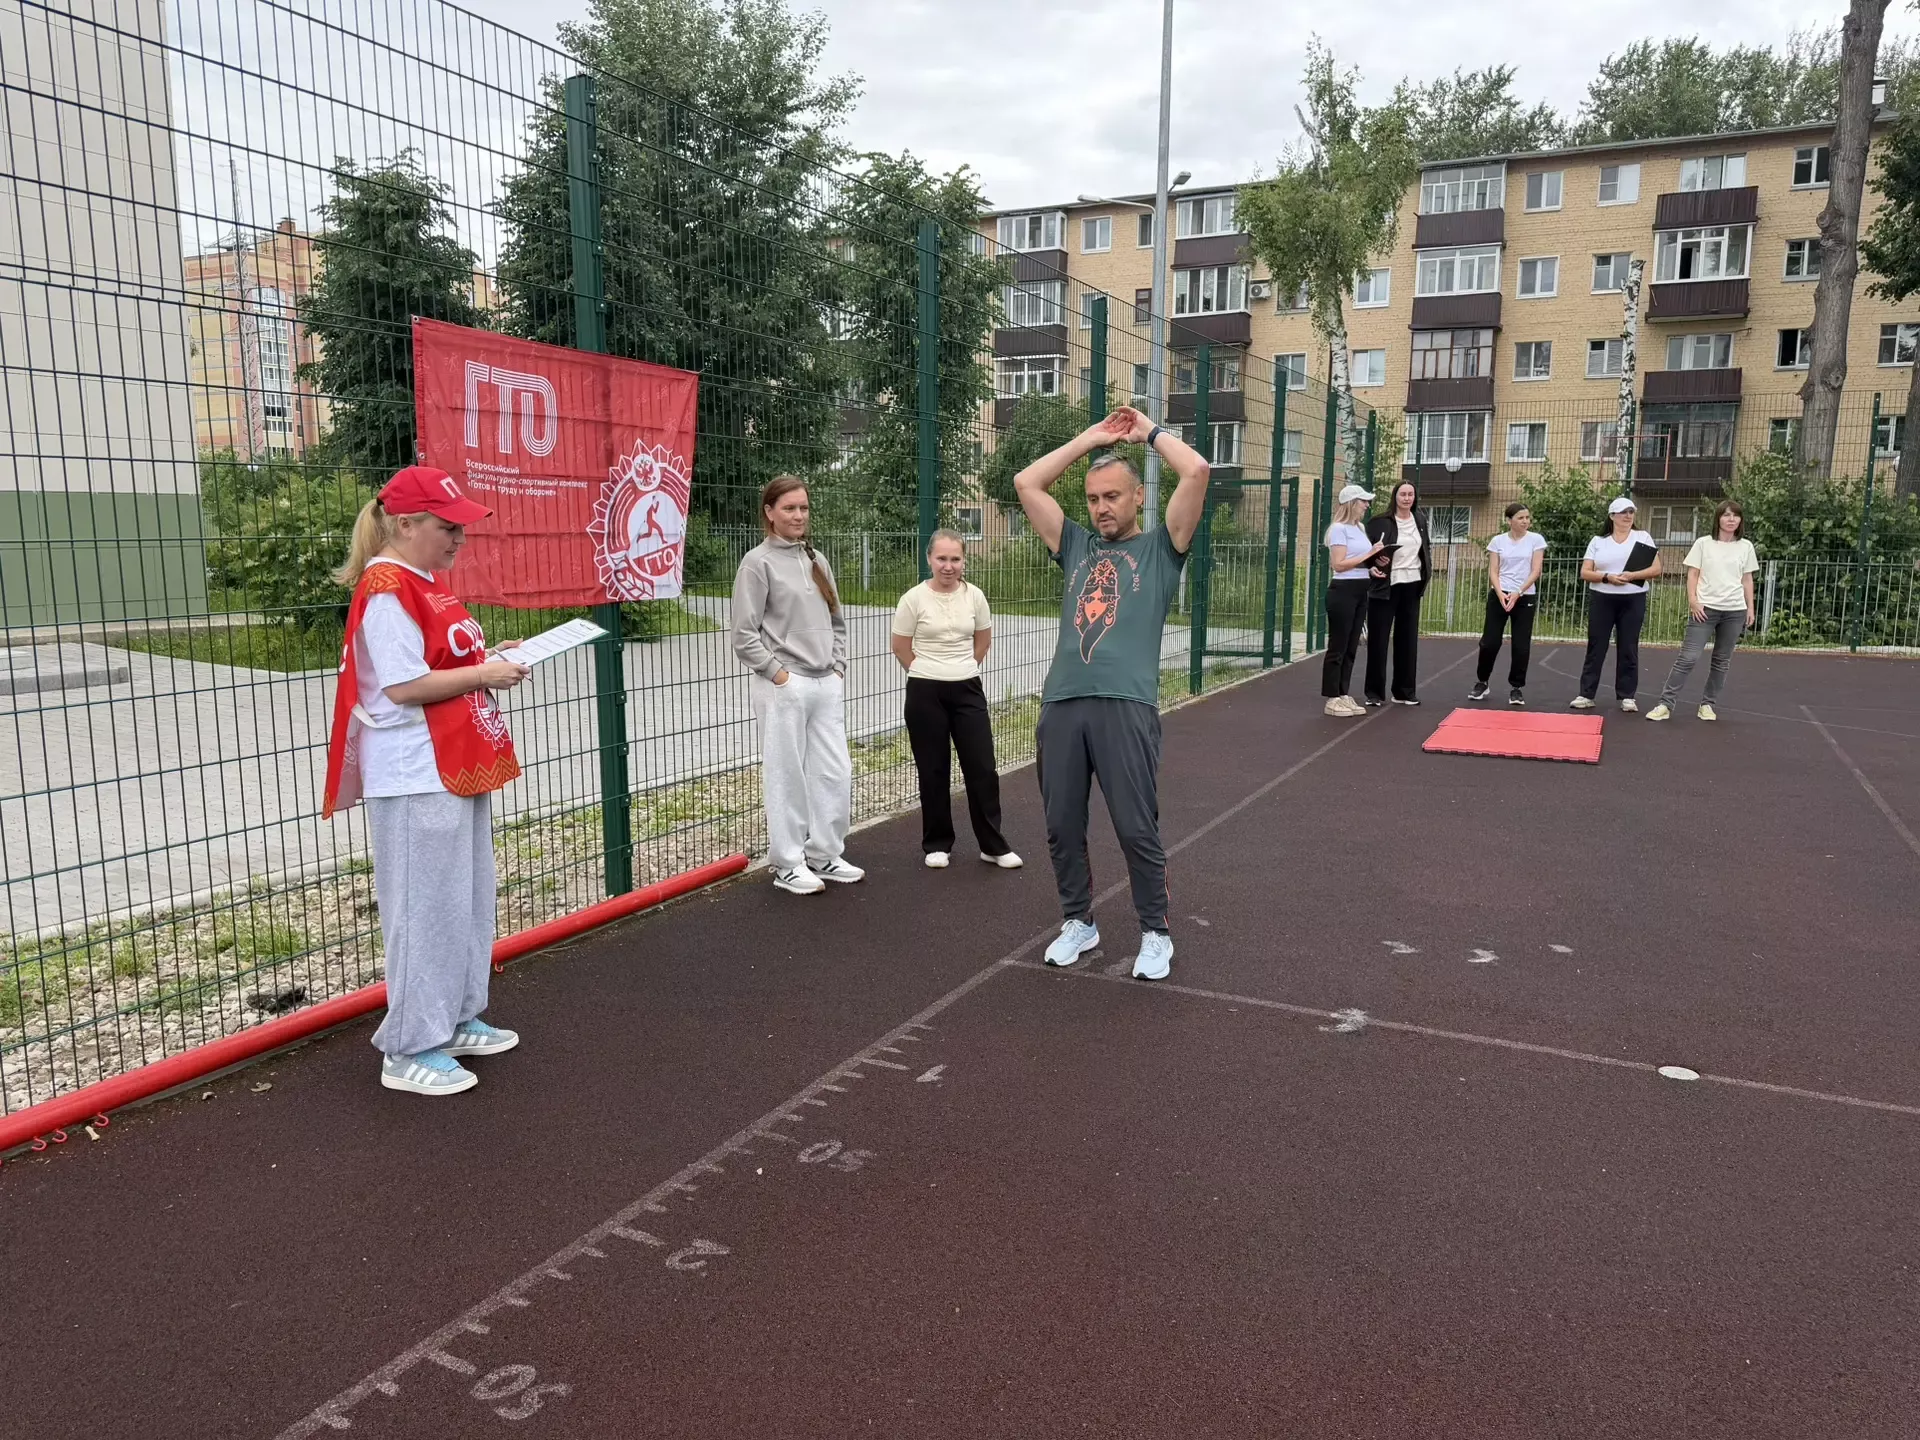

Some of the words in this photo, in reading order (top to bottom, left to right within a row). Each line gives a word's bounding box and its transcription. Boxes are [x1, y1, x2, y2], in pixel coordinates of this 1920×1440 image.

[465, 360, 558, 456] ГТО
[465, 459, 520, 475] Всероссийский
[466, 469, 559, 487] физкультурно-спортивный
[559, 480, 588, 489] комплекс
[467, 479, 491, 491] «Готов
[497, 485, 518, 496] труду
[643, 547, 676, 575] ГТО
[1132, 572, 1141, 592] 2024
[470, 1363, 573, 1421] 50
